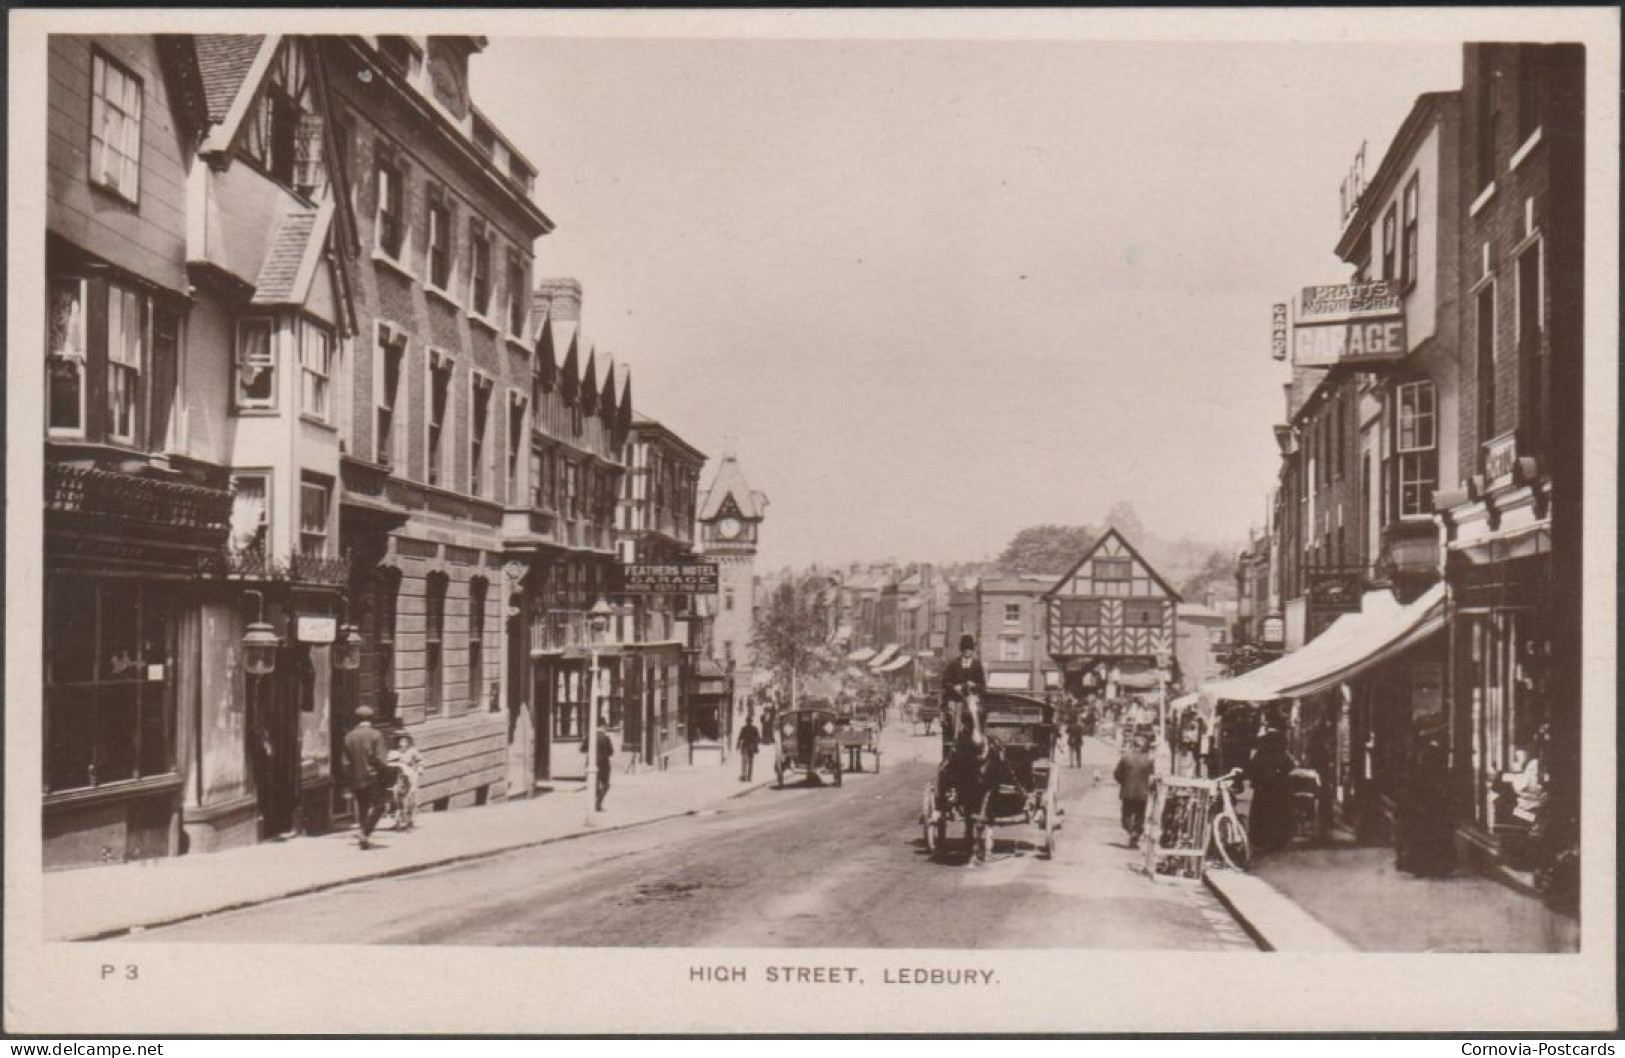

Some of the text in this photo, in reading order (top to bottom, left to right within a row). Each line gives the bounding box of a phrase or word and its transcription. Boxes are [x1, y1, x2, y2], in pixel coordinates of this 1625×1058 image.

[1296, 322, 1403, 359] GARAGE
[624, 564, 716, 576] FEATHERS HOTEL
[630, 576, 711, 584] GARAGE
